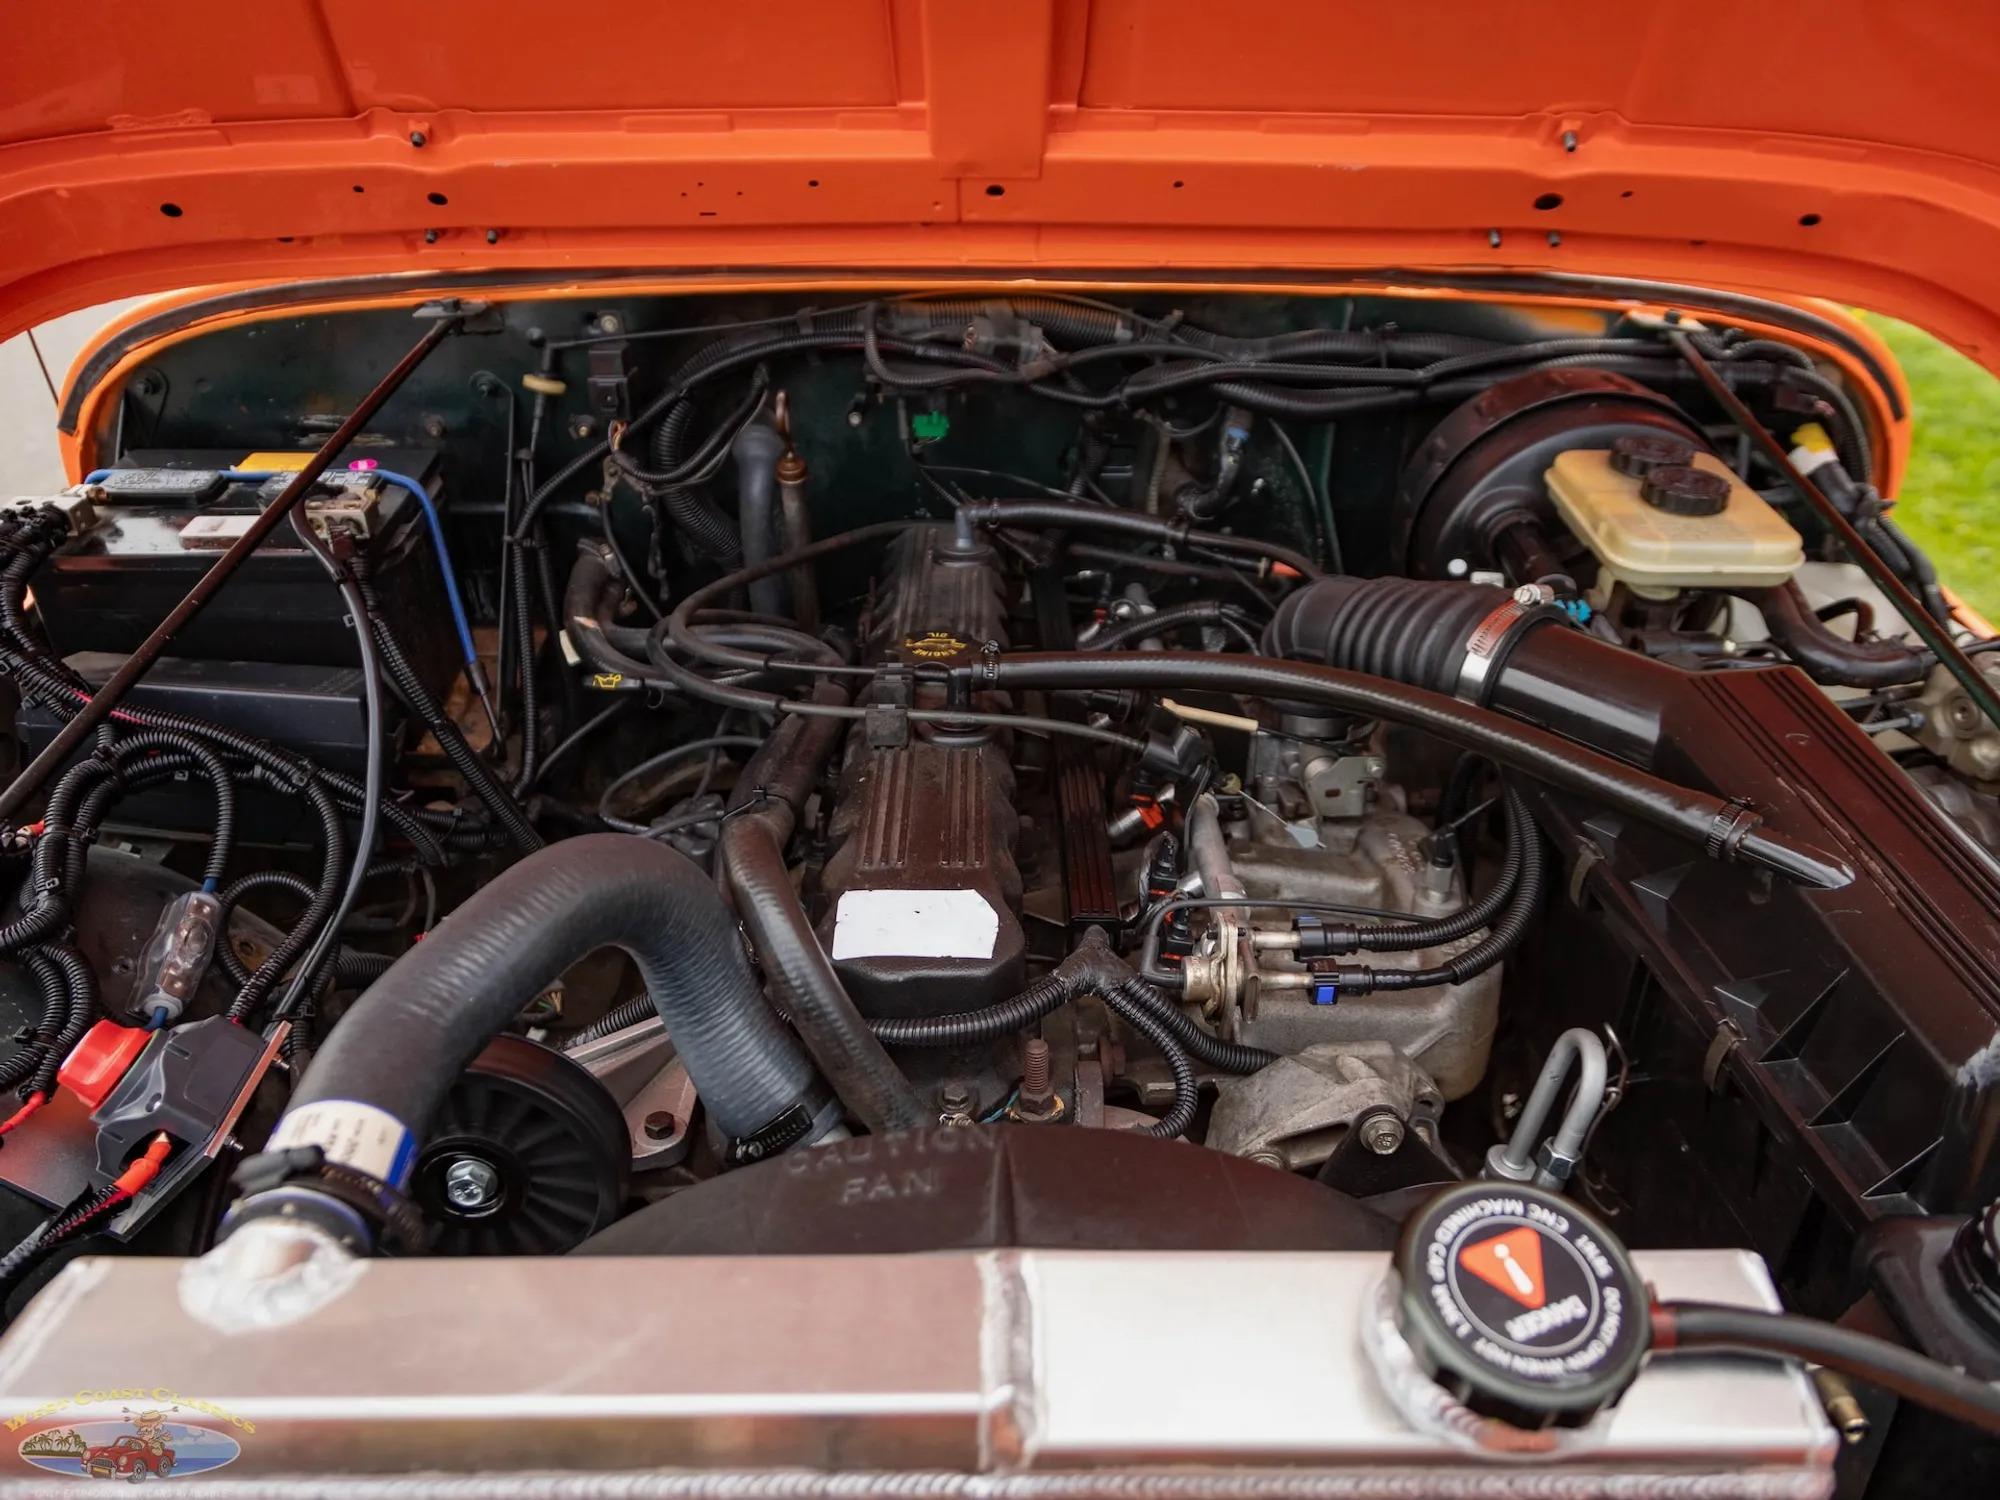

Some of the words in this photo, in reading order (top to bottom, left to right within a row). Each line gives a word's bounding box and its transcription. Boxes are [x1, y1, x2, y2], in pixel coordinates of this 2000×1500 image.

[785, 1127, 996, 1175] CAUTION
[842, 1171, 934, 1204] FAN
[1435, 1198, 1524, 1243] MACHINED
[1526, 1201, 1570, 1235] CNC
